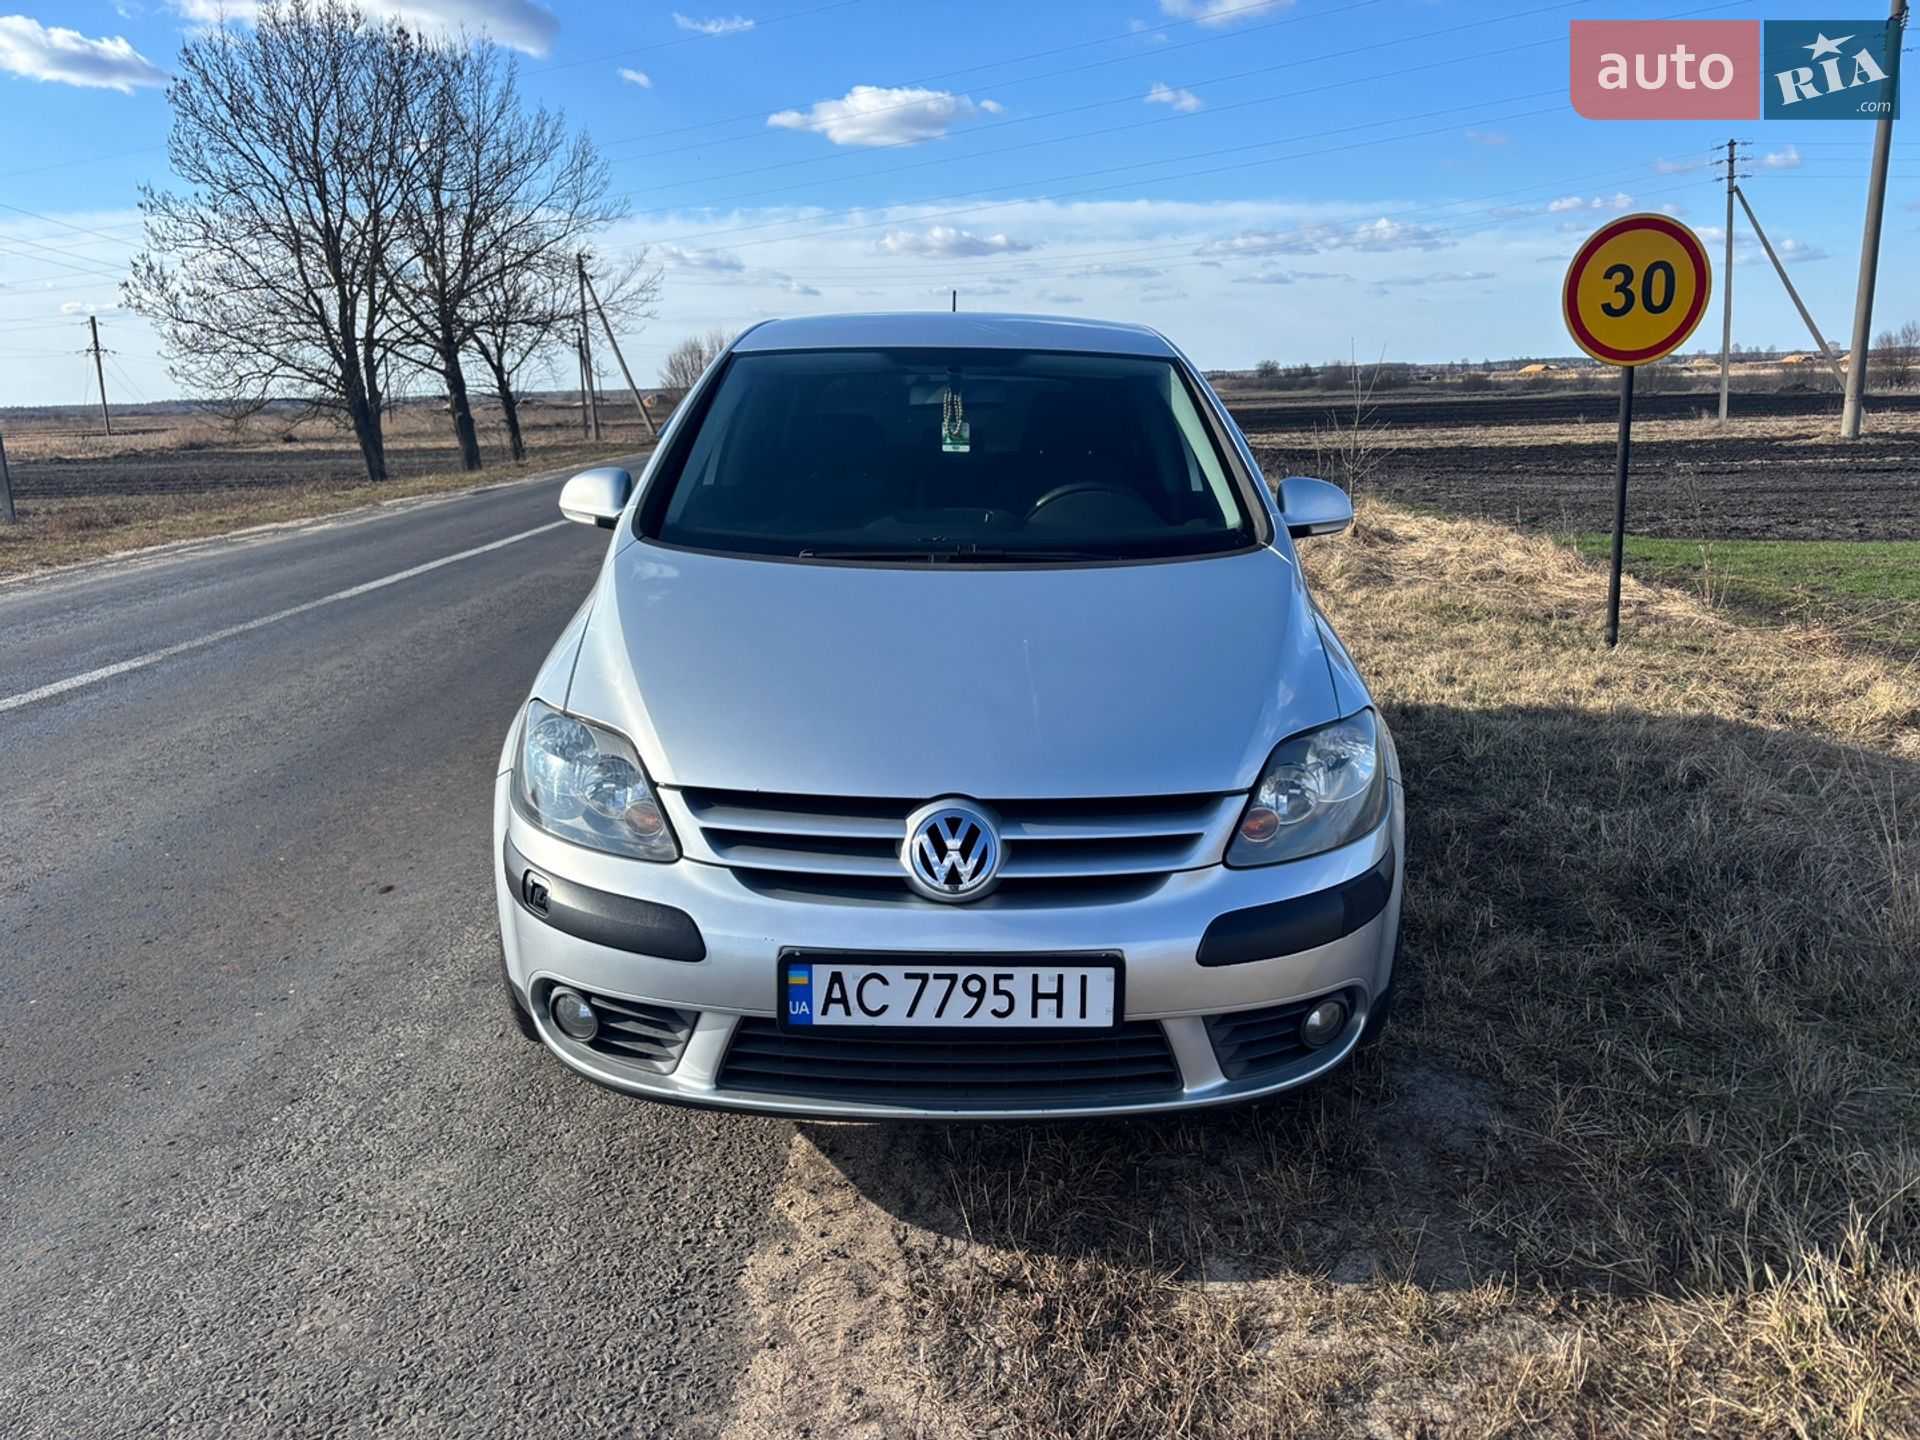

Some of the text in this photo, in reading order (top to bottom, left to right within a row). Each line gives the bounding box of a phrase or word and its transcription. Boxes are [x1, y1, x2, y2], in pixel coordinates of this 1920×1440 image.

[1600, 260, 1676, 318] 30
[789, 1000, 810, 1015] UA
[820, 971, 1088, 1019] AC 7795 HI
